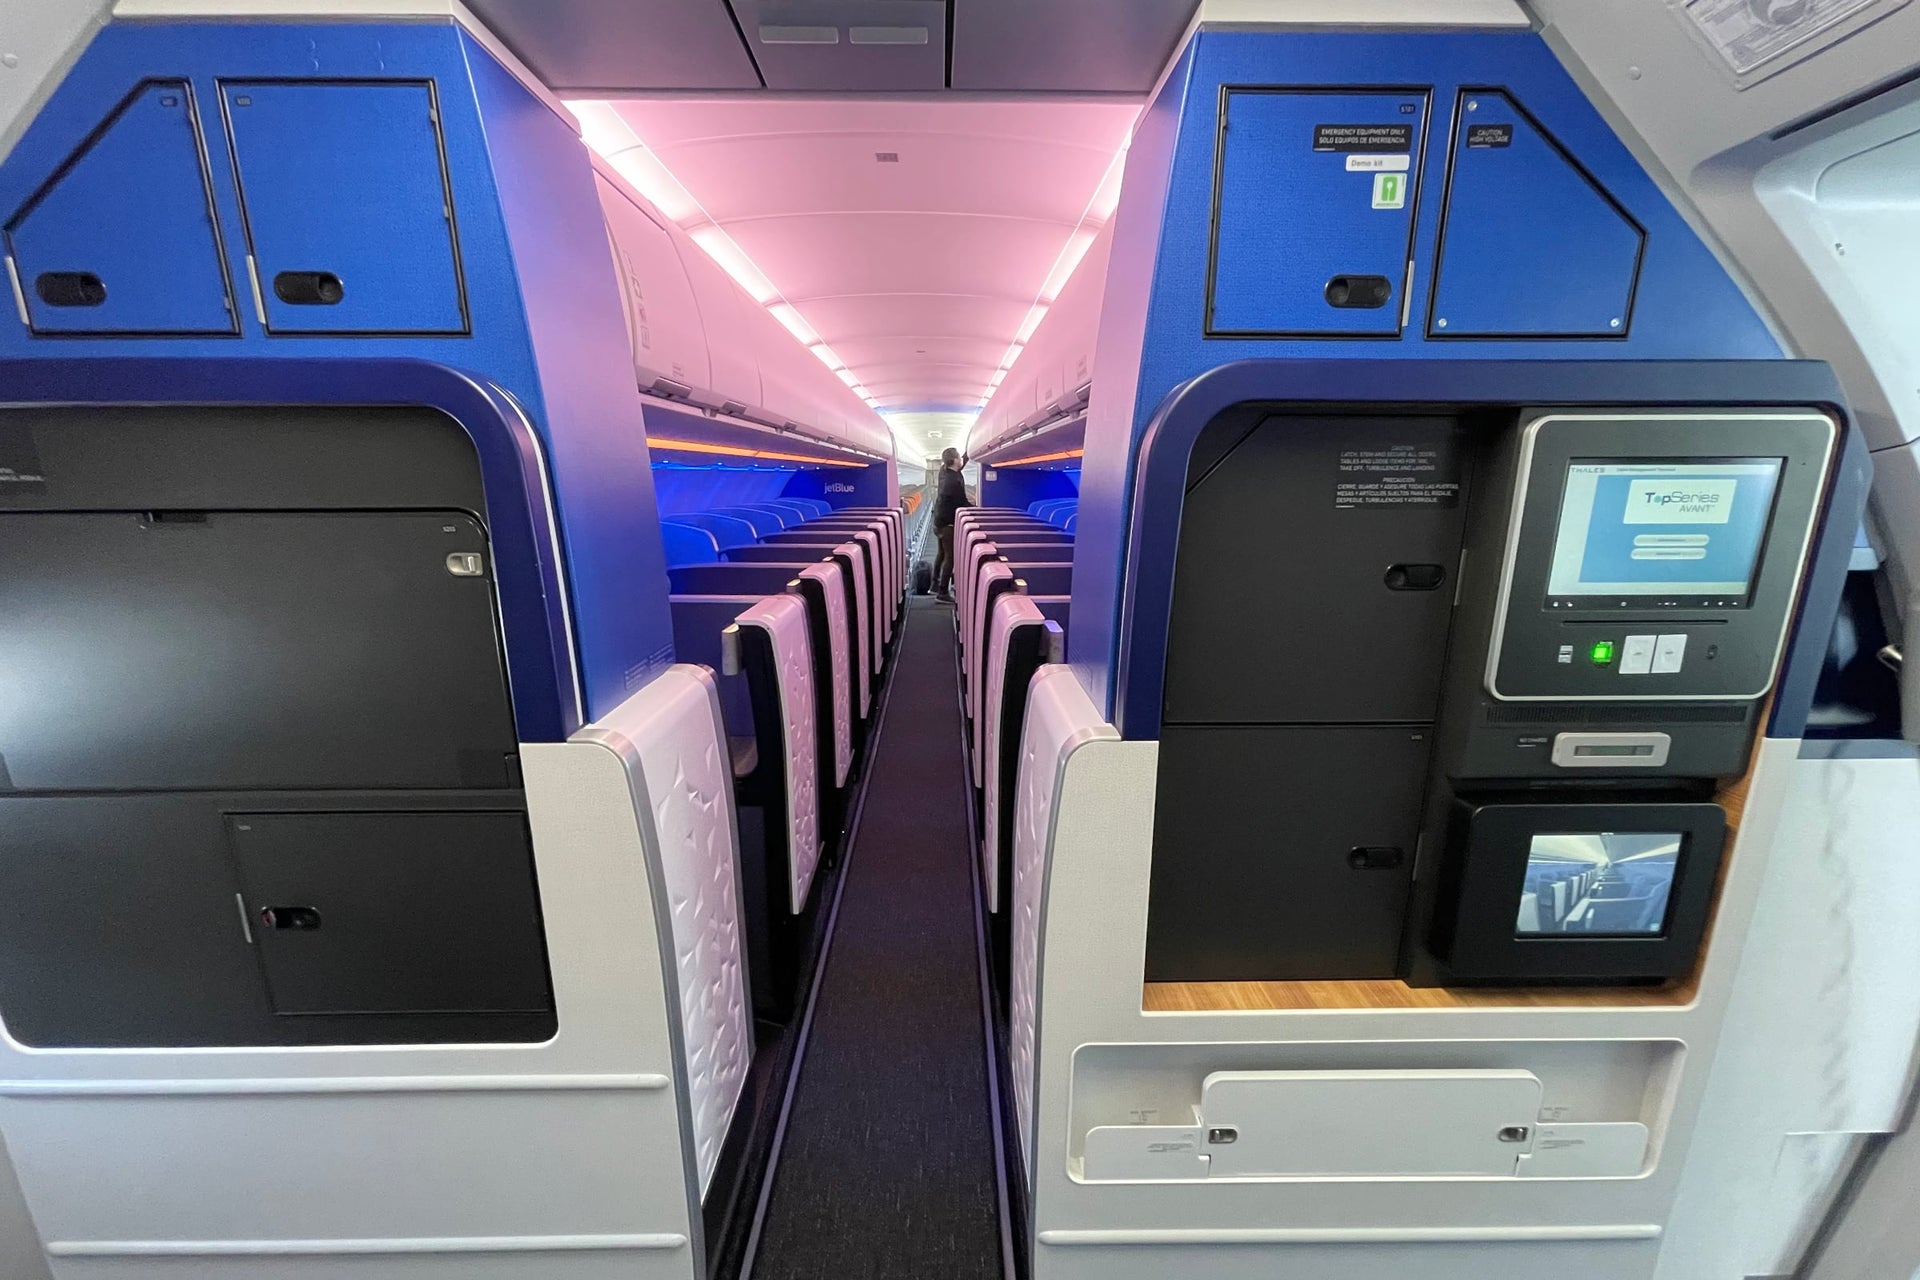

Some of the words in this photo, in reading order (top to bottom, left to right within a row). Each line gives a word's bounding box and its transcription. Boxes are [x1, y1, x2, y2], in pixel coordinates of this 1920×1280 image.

[1319, 136, 1334, 144] SOLO
[1334, 136, 1359, 144] EQUIPOS
[1359, 136, 1368, 144] DE
[1368, 136, 1406, 144] EMERGENCIA
[1351, 159, 1372, 167] Demo
[824, 482, 855, 494] jetBlue
[1645, 491, 1720, 506] TopSeries
